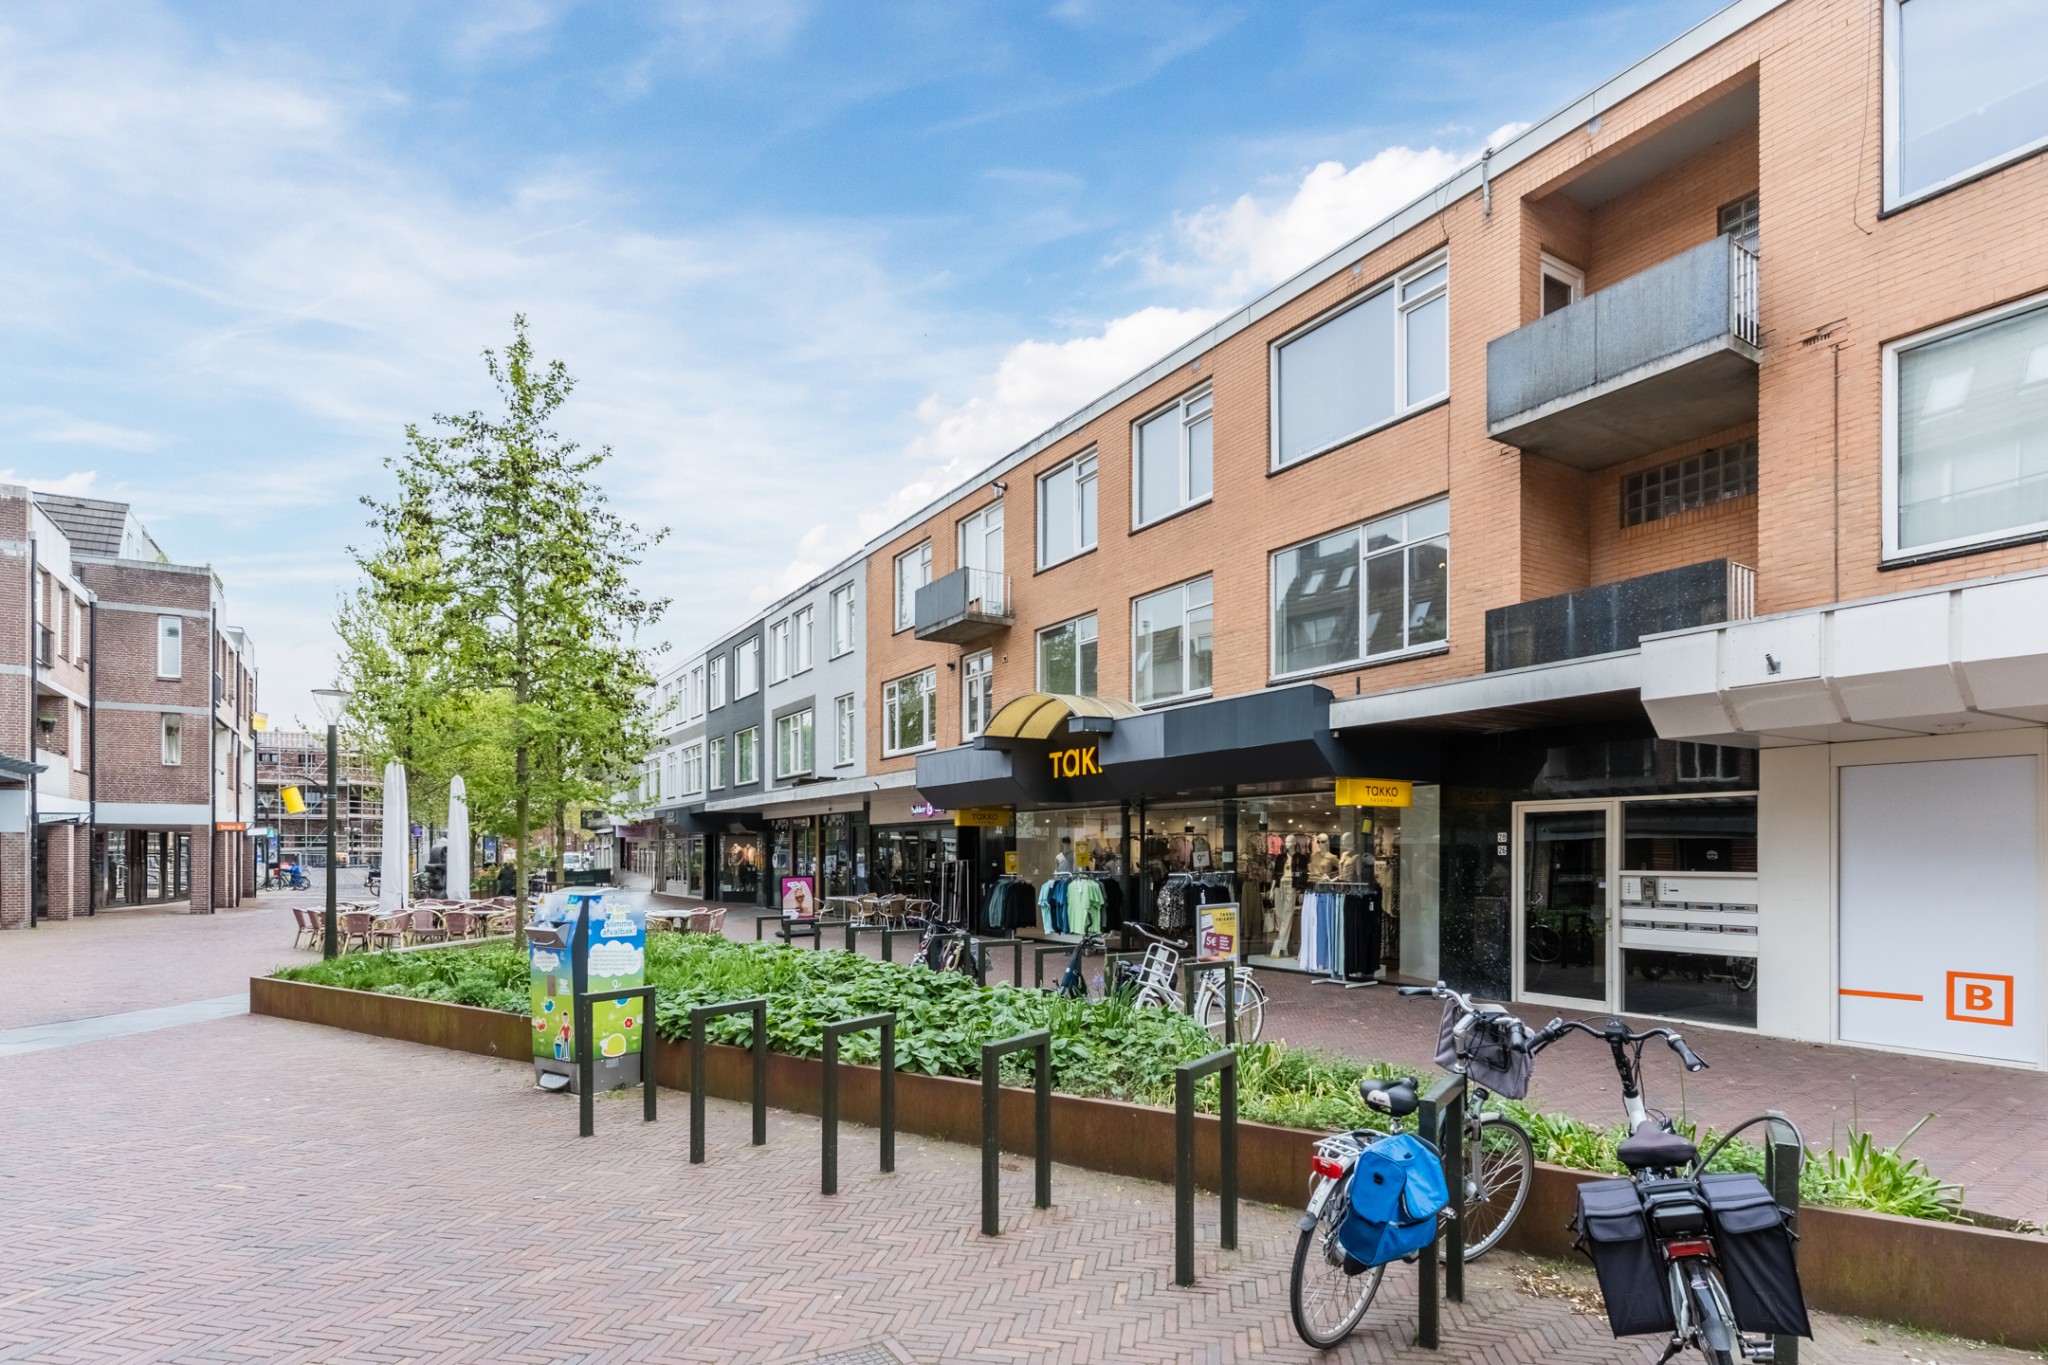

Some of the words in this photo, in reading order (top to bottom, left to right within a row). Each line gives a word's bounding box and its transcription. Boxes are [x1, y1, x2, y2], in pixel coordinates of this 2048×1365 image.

[606, 920, 633, 928] slimme
[602, 927, 636, 936] afvalbak!
[1965, 983, 1993, 1011] B
